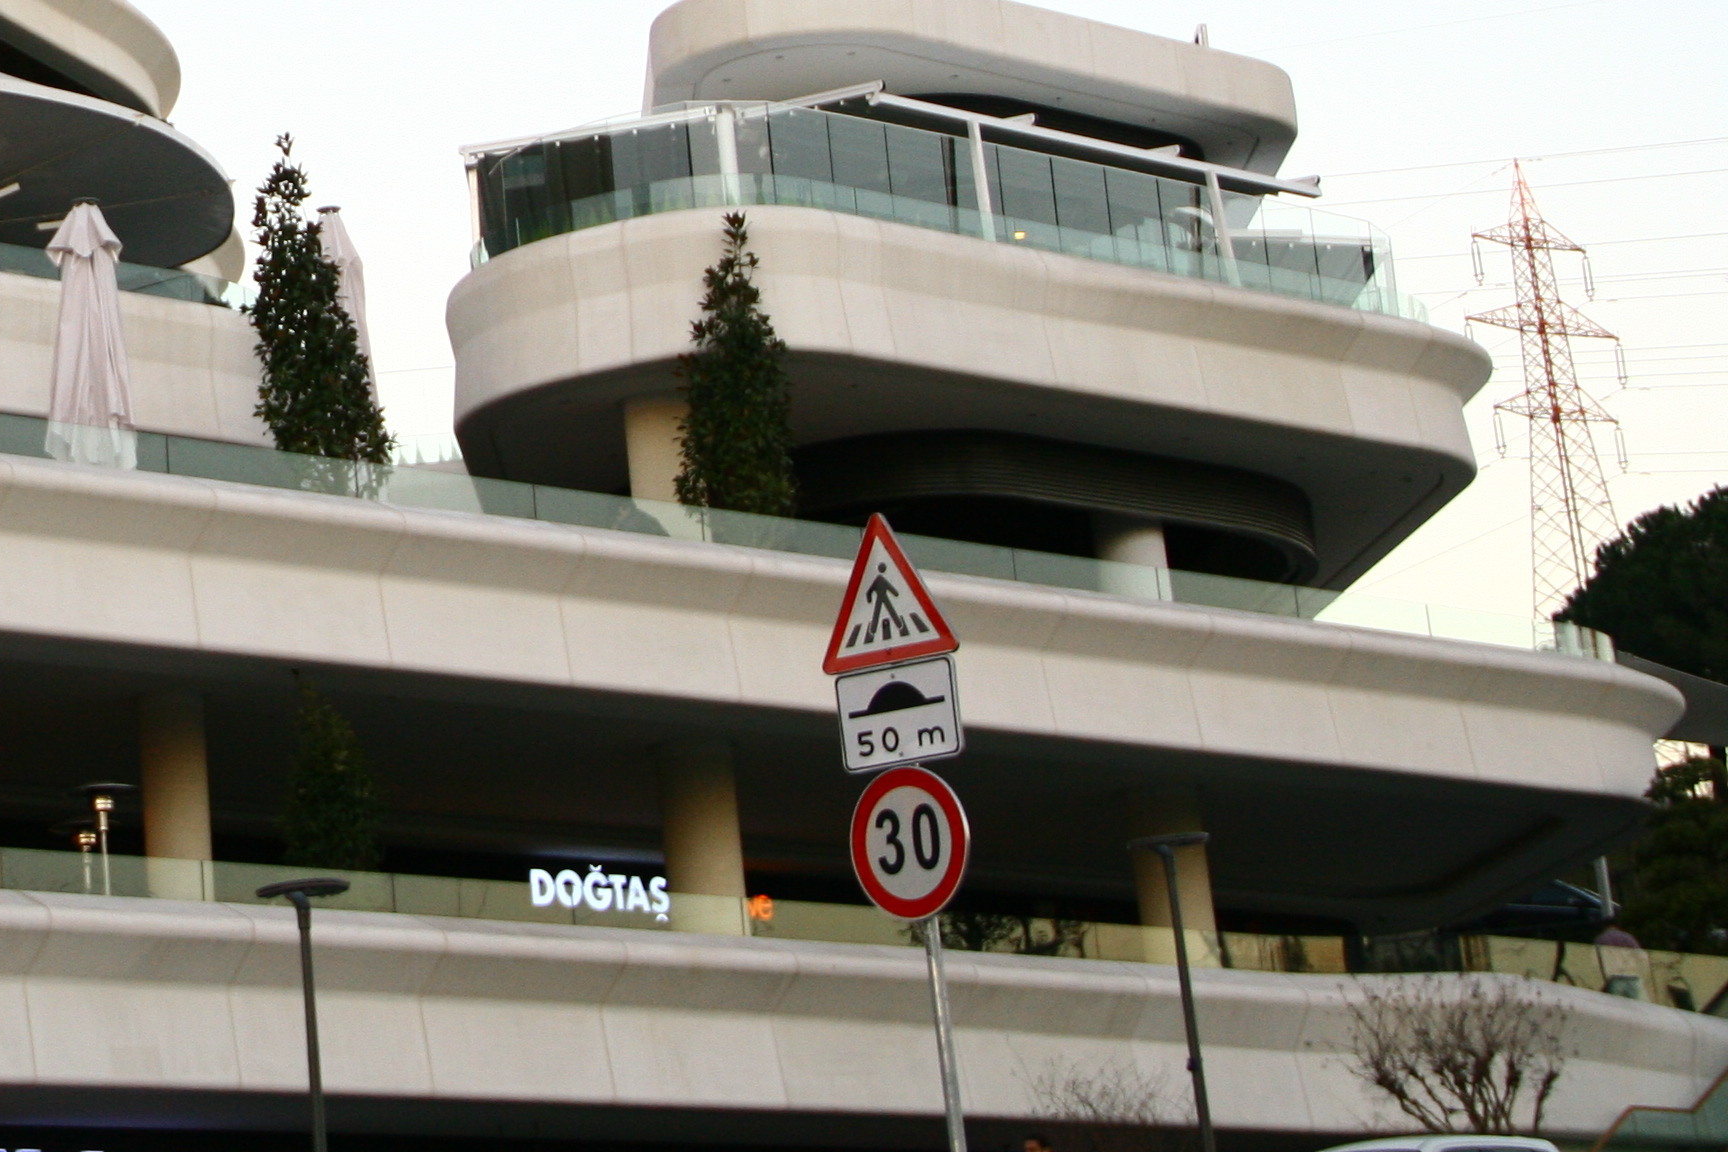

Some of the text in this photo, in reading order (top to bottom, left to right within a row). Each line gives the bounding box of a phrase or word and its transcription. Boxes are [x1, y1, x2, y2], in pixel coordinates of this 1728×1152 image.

[857, 724, 945, 757] 50 m
[875, 803, 941, 876] 30
[529, 863, 670, 923] DOĞTAŞ
